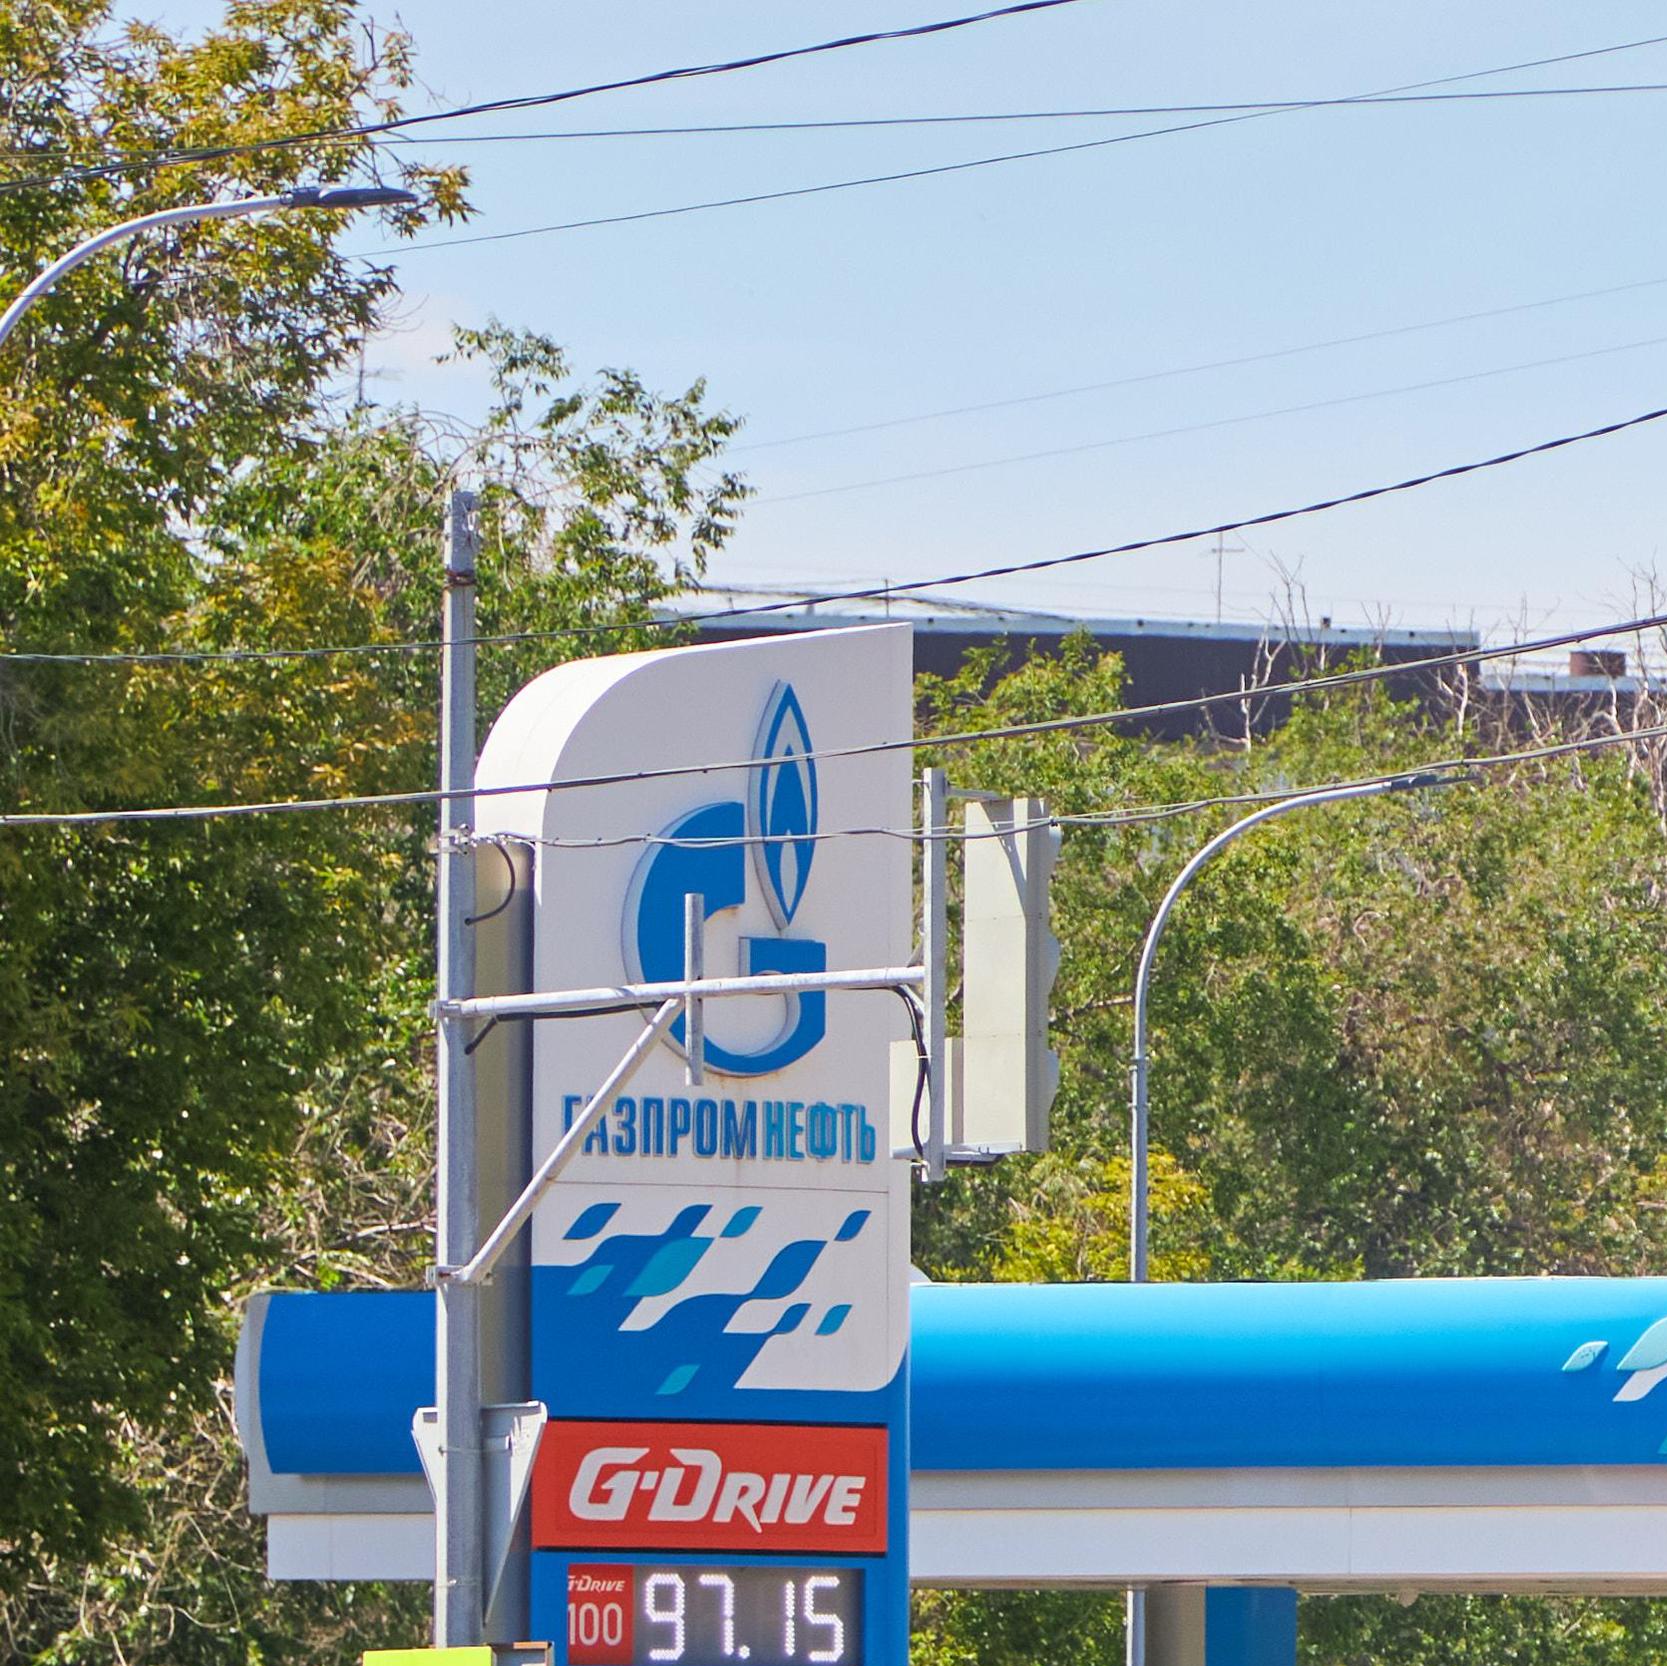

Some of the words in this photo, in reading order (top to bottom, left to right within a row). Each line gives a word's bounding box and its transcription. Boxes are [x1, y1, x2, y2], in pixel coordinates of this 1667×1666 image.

[562, 1094, 877, 1165] ГАЗПРОМНЕФТЬ
[567, 1602, 623, 1647] 100
[645, 1572, 845, 1662] 97.15
